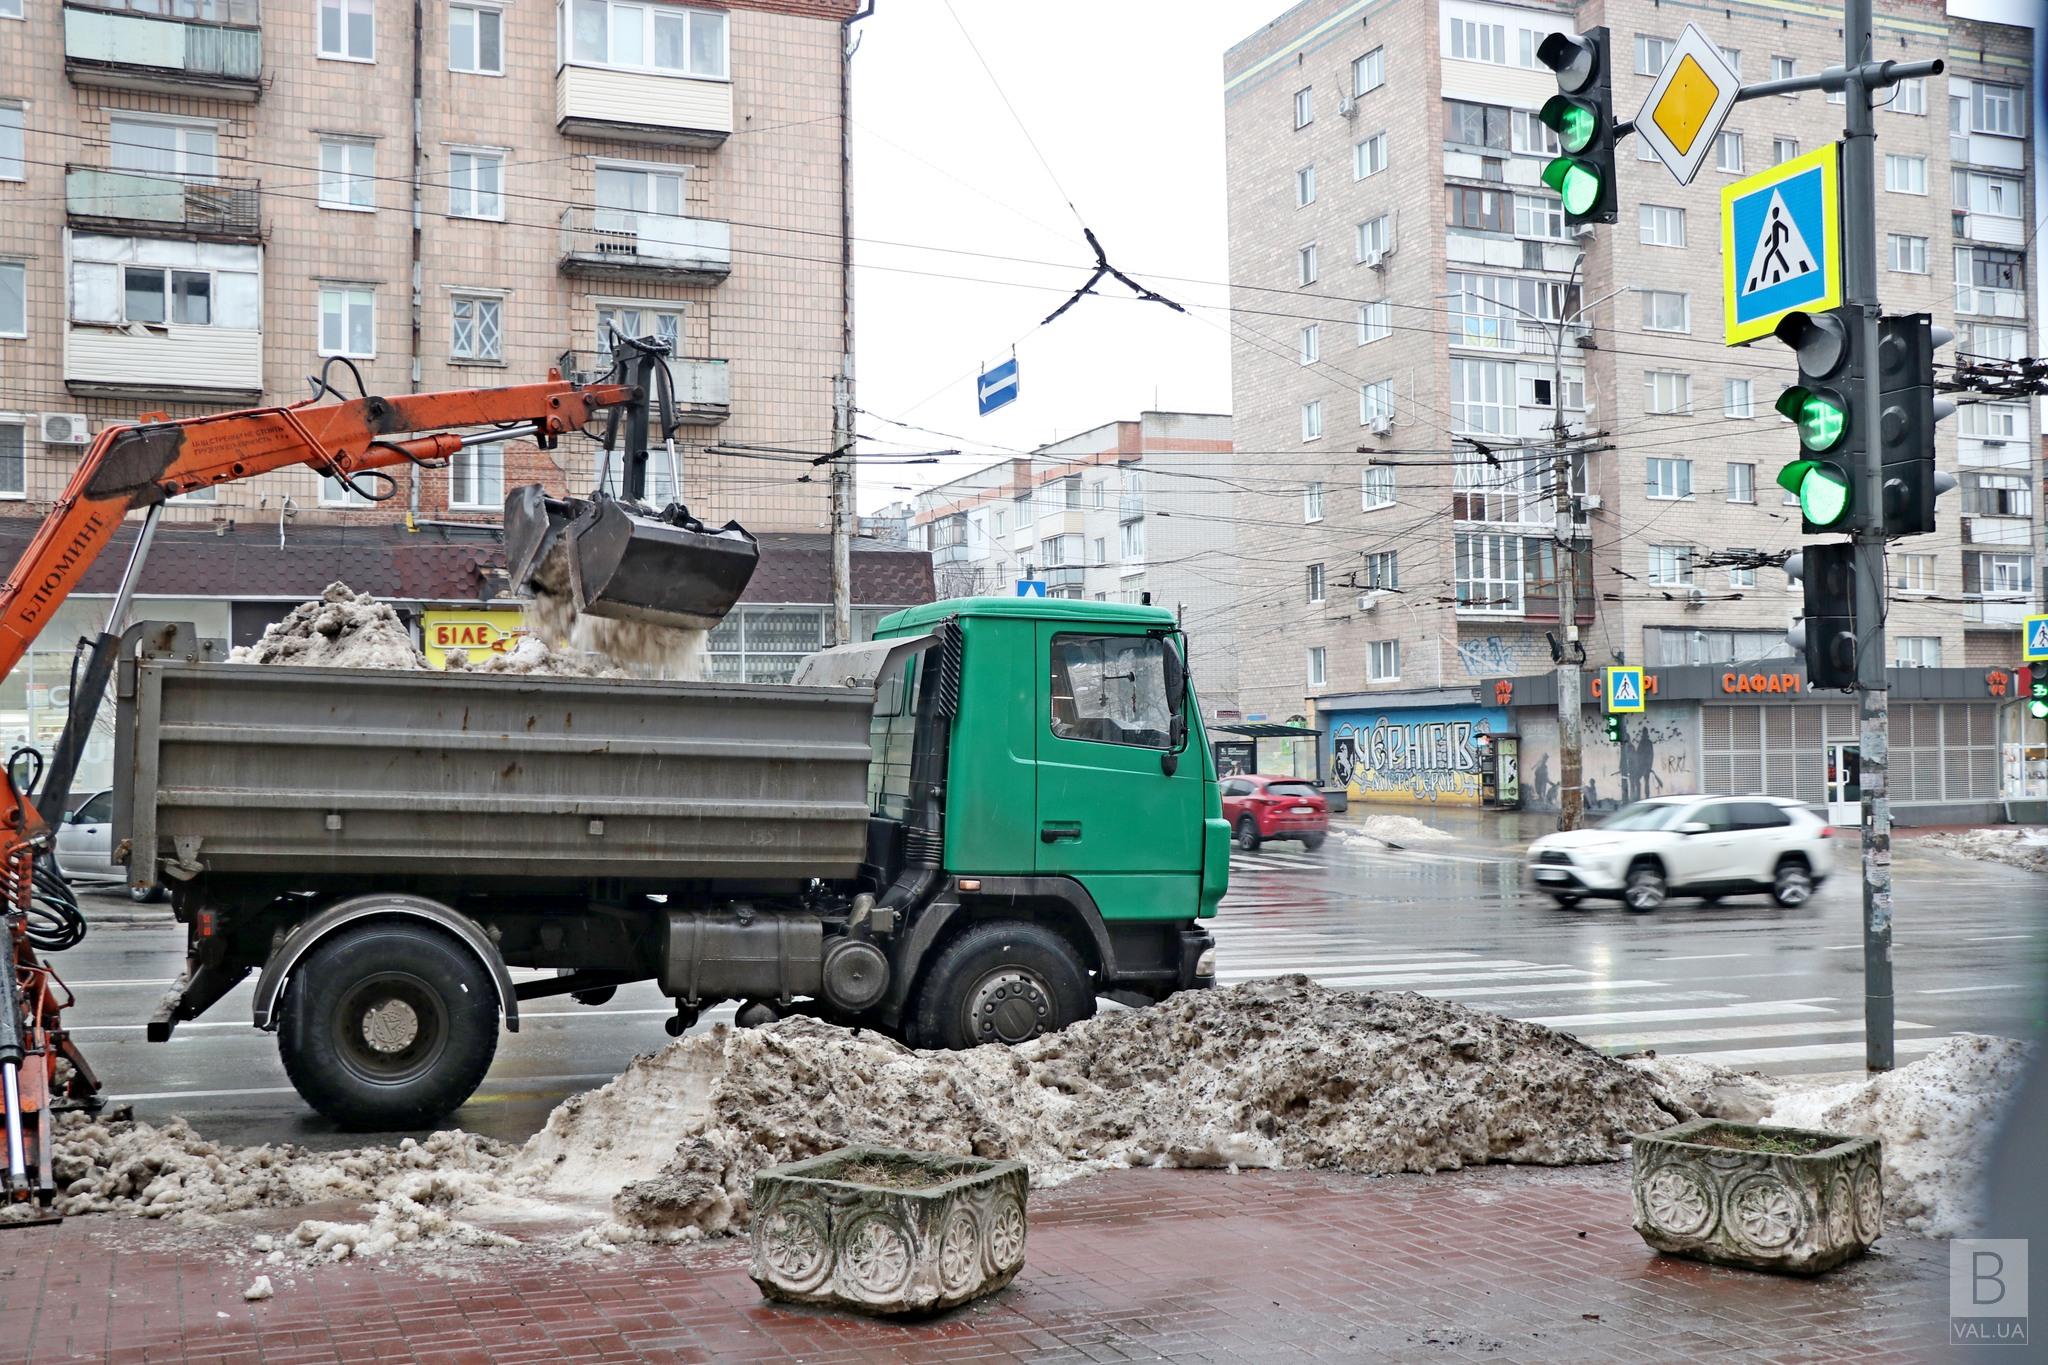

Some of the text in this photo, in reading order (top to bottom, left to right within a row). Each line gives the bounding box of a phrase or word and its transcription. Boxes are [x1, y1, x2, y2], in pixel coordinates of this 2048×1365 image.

[20, 511, 103, 624] БЛЮМИНГ
[437, 626, 488, 644] БІЛЕ
[1722, 672, 1801, 693] САФАРІ
